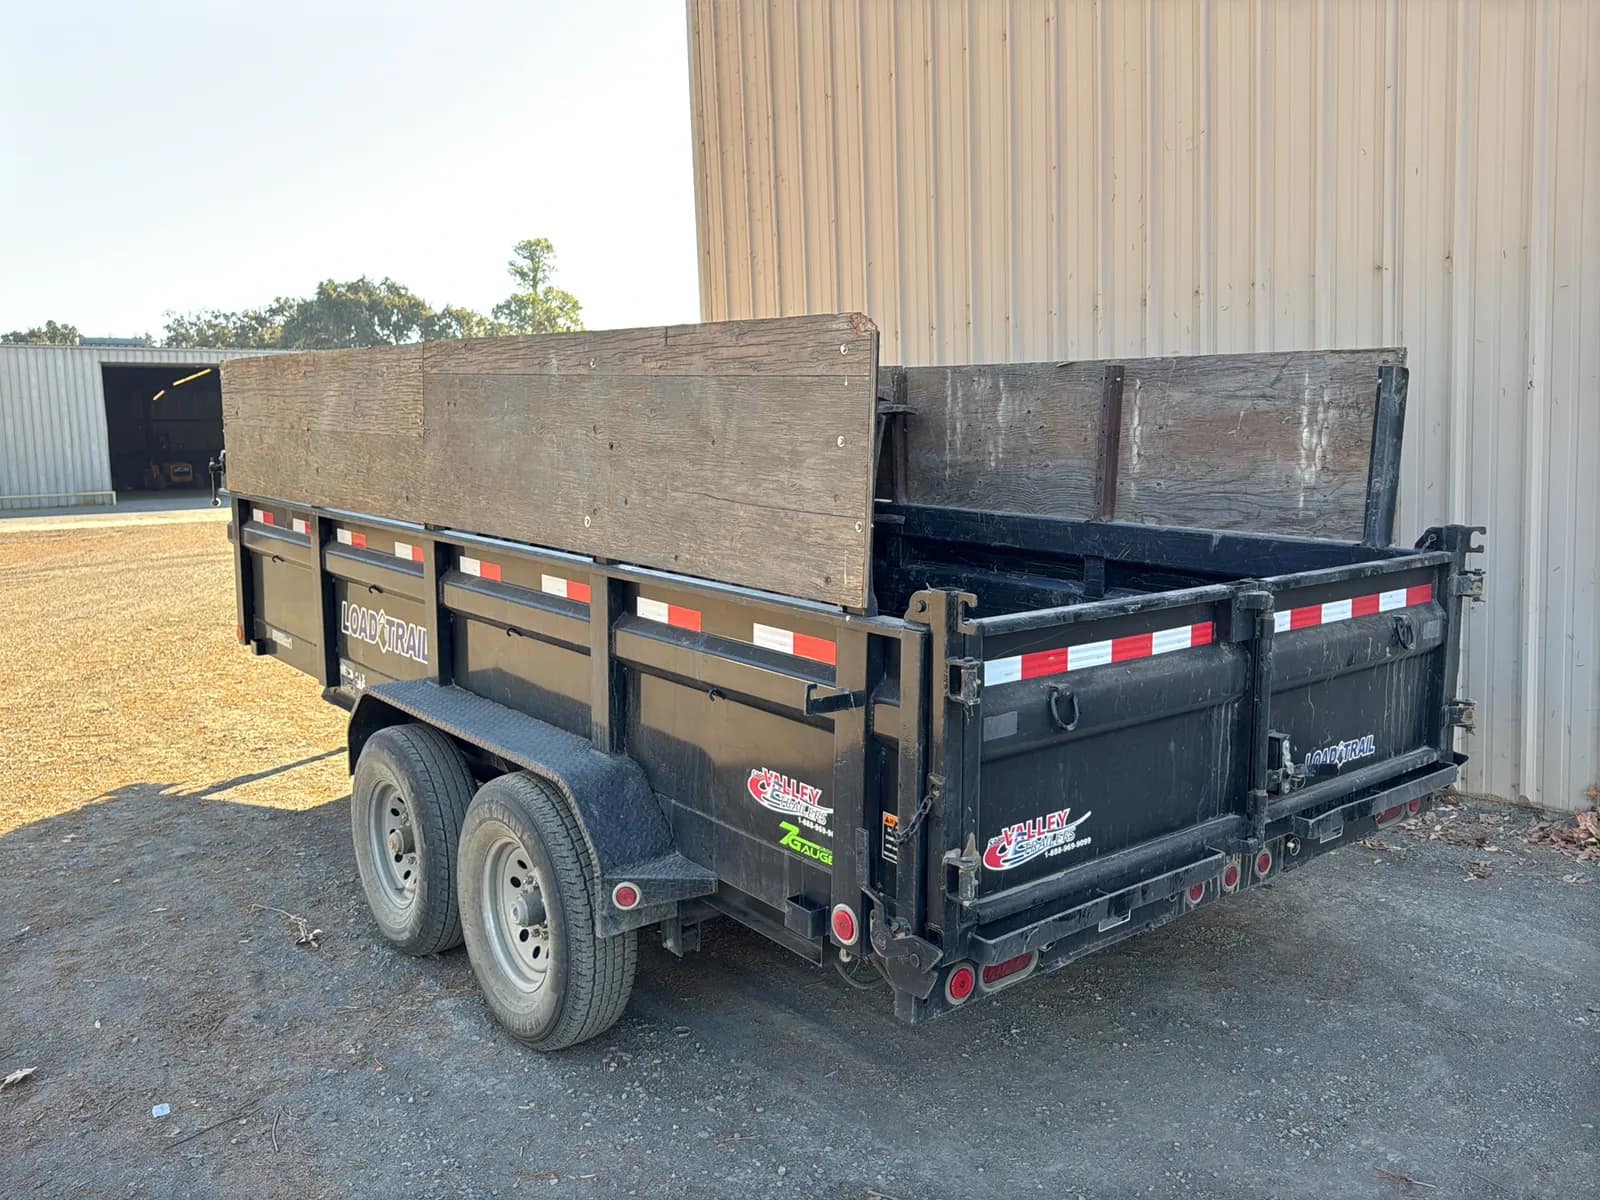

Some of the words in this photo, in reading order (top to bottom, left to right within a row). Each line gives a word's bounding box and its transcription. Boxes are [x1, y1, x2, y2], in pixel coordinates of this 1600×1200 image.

[341, 600, 379, 644] LOAD
[385, 615, 429, 665] TRAIL
[1305, 746, 1338, 774] LOAD
[1343, 734, 1376, 763] TRAIL
[761, 767, 822, 807] VALLEY
[1002, 808, 1071, 847] VALLEY
